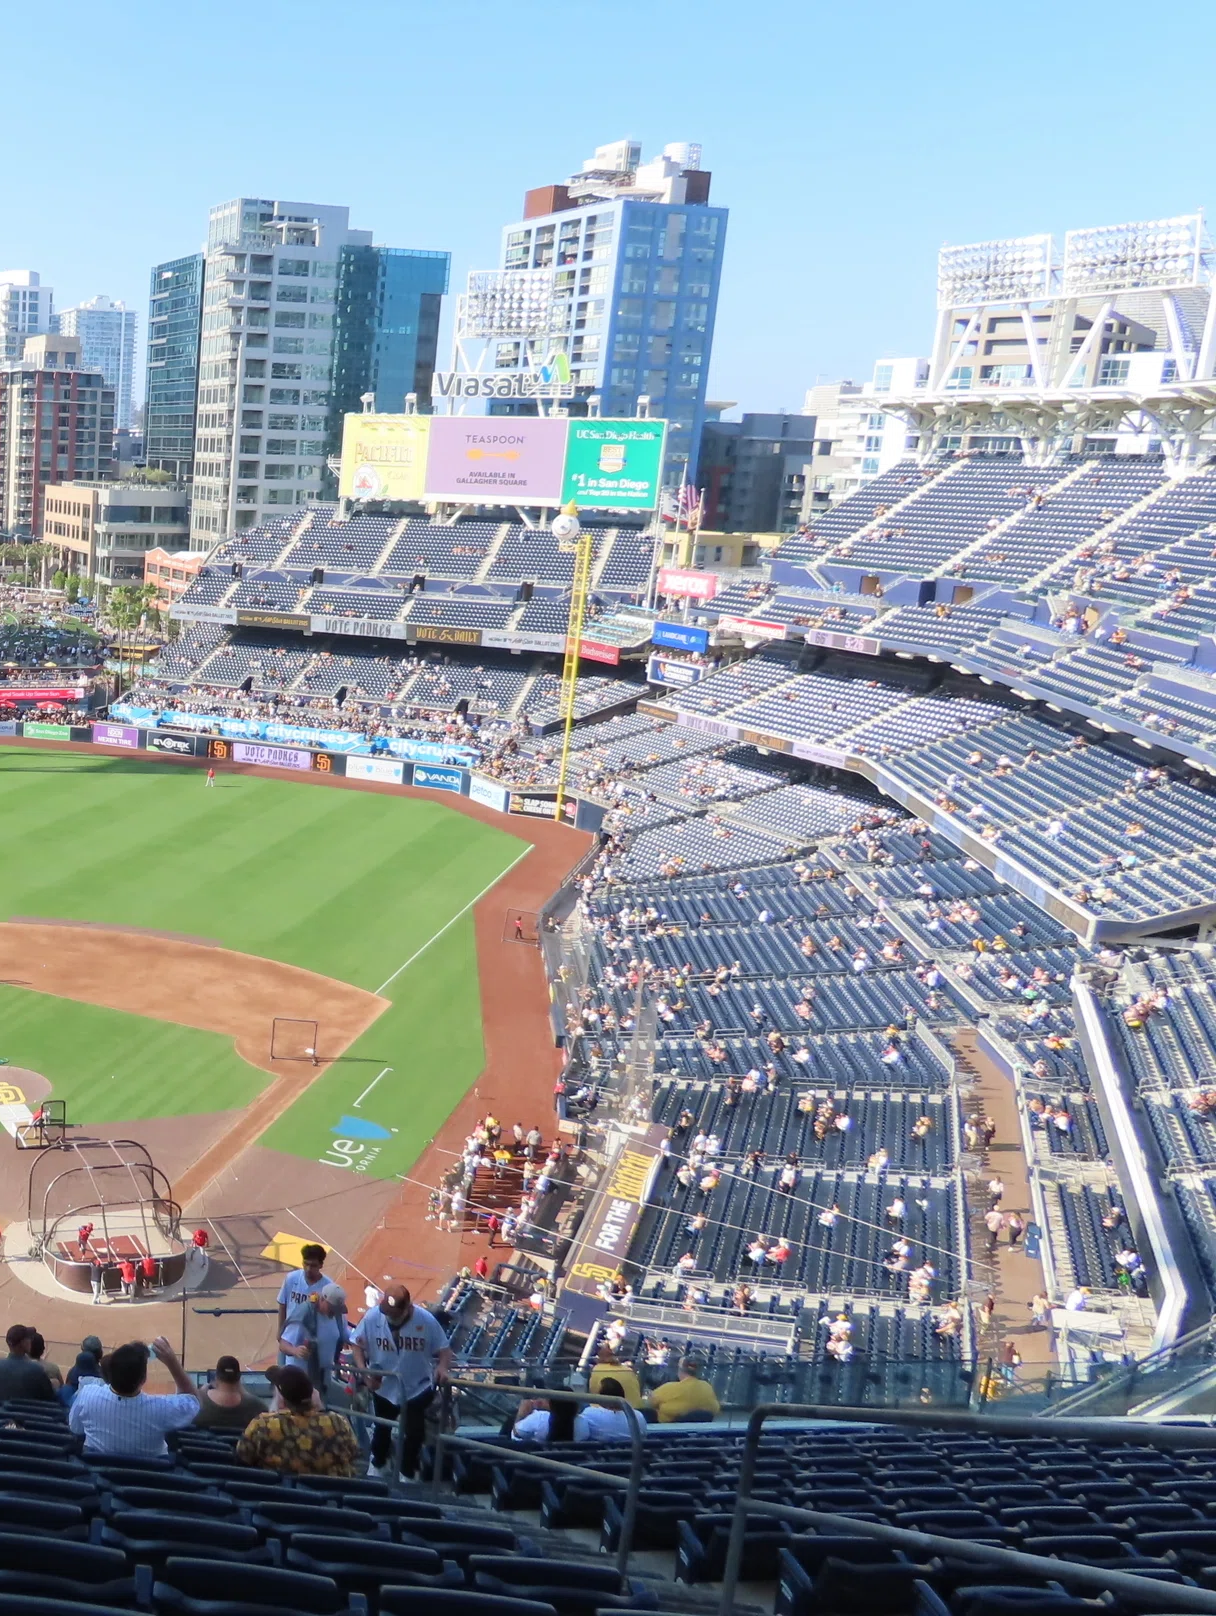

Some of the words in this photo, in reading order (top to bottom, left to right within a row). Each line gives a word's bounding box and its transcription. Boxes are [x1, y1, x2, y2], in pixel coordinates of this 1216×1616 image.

[436, 372, 528, 398] Viasat
[464, 434, 524, 445] TEASPOON
[456, 477, 499, 486] GALLAGHER
[500, 479, 527, 487] SQUARE
[468, 471, 505, 479] AVAILABLE
[587, 478, 597, 487] in
[598, 478, 618, 488] San
[619, 479, 650, 490] Diego
[663, 574, 708, 594] xerox
[416, 627, 437, 639] VOTE
[454, 630, 479, 642] DAILY
[581, 645, 615, 660] Budweiser
[214, 741, 227, 759] SD
[317, 754, 331, 772] SD
[352, 1147, 382, 1174] ORNIA
[606, 1199, 632, 1222] THE
[595, 1219, 624, 1250] FOR
